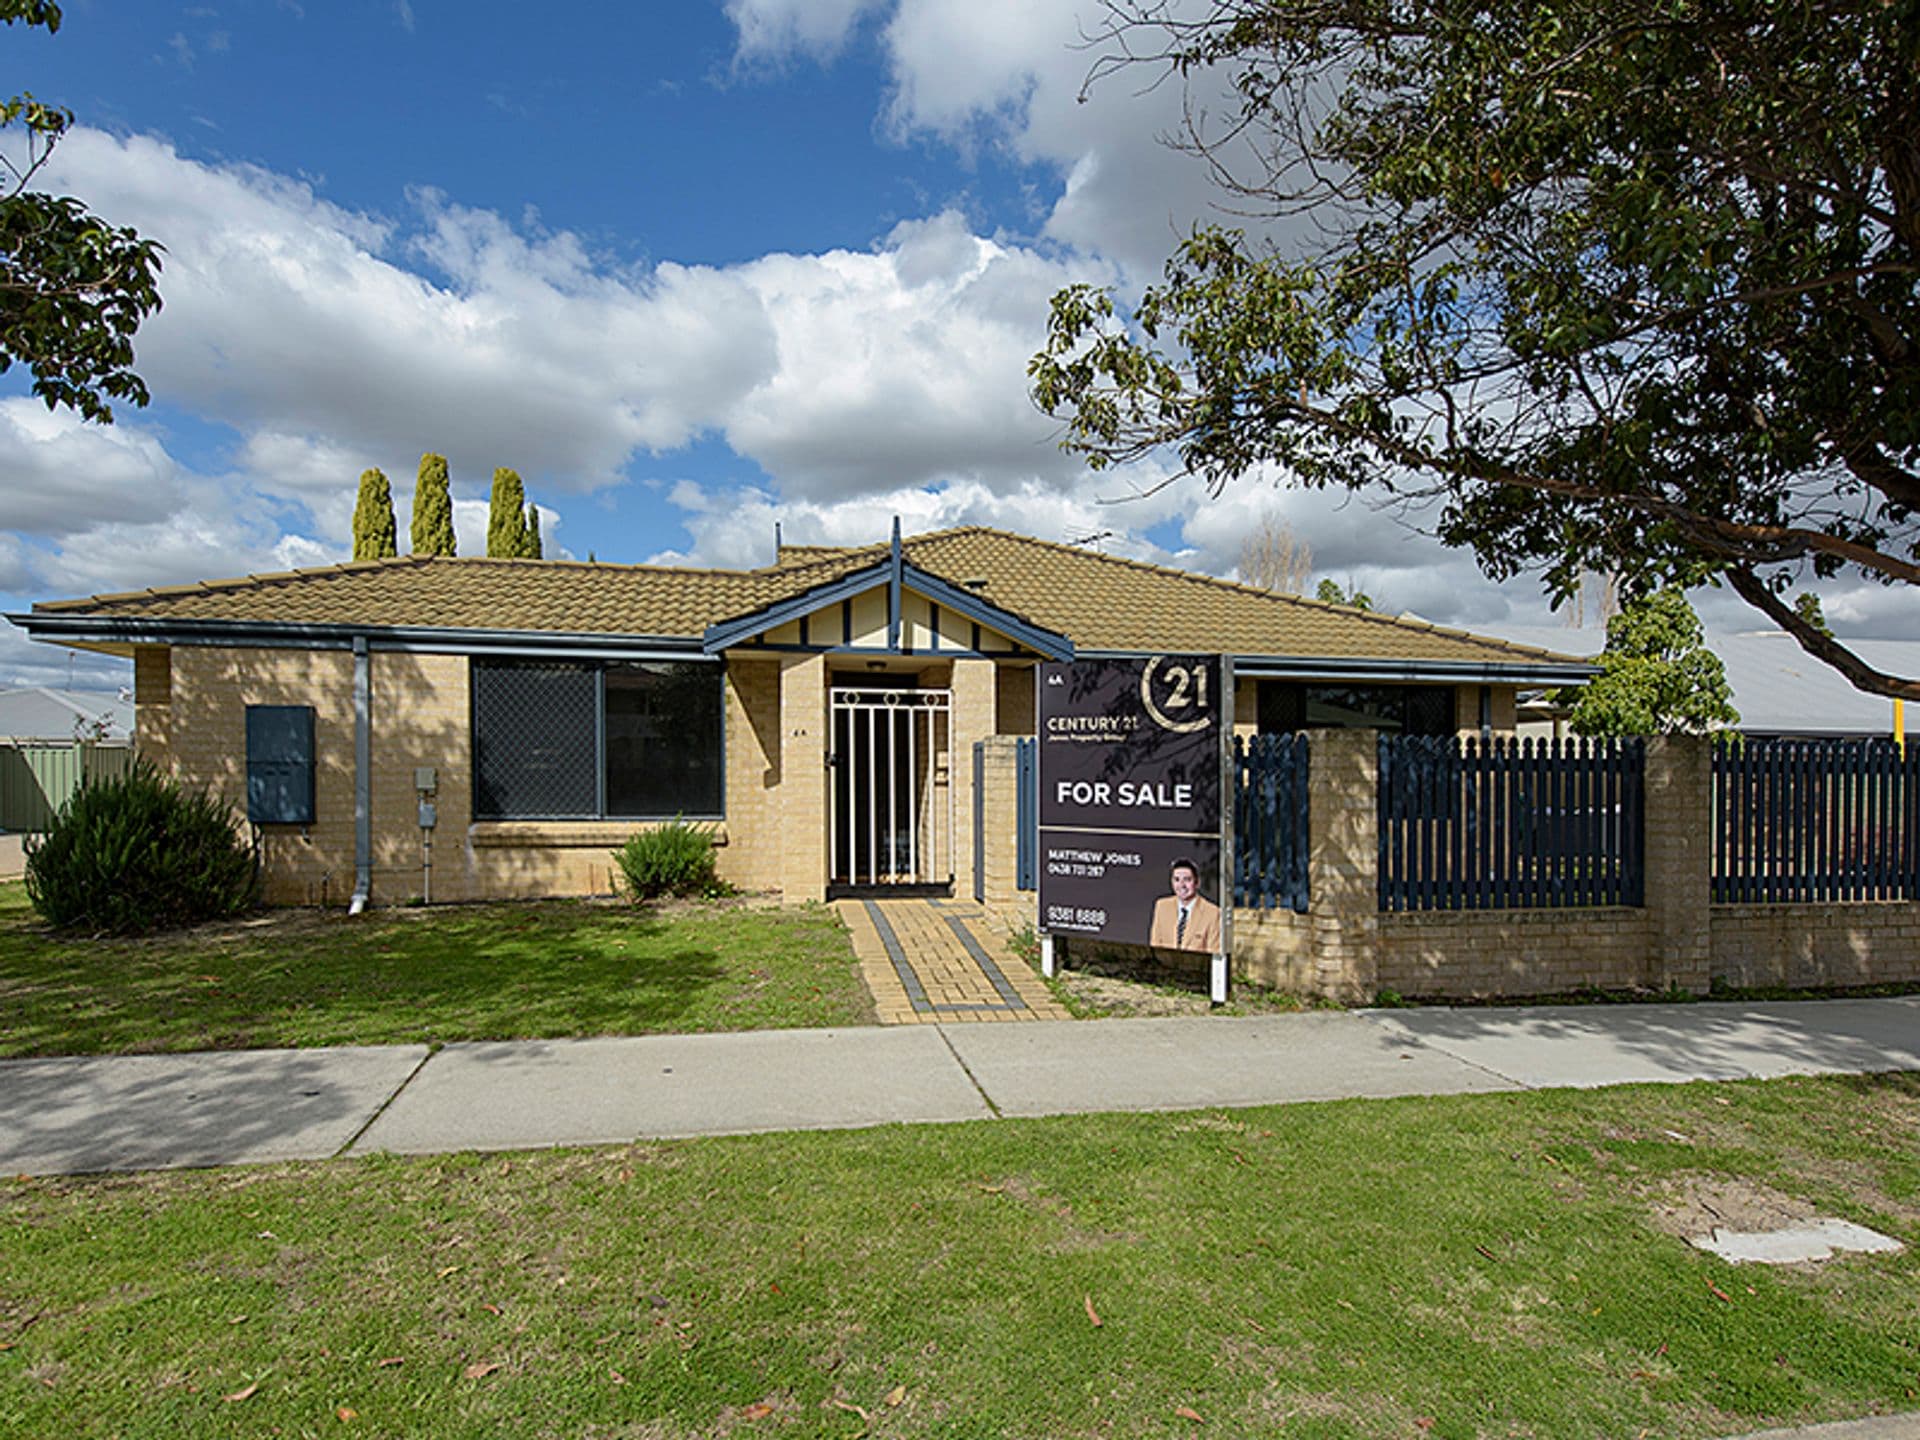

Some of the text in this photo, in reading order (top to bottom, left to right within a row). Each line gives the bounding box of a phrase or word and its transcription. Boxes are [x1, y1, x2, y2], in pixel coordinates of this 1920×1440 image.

[1046, 717, 1119, 731] CENTURY
[1057, 782, 1193, 808] FOR SALE
[1048, 849, 1141, 866] MATTHEW JONES
